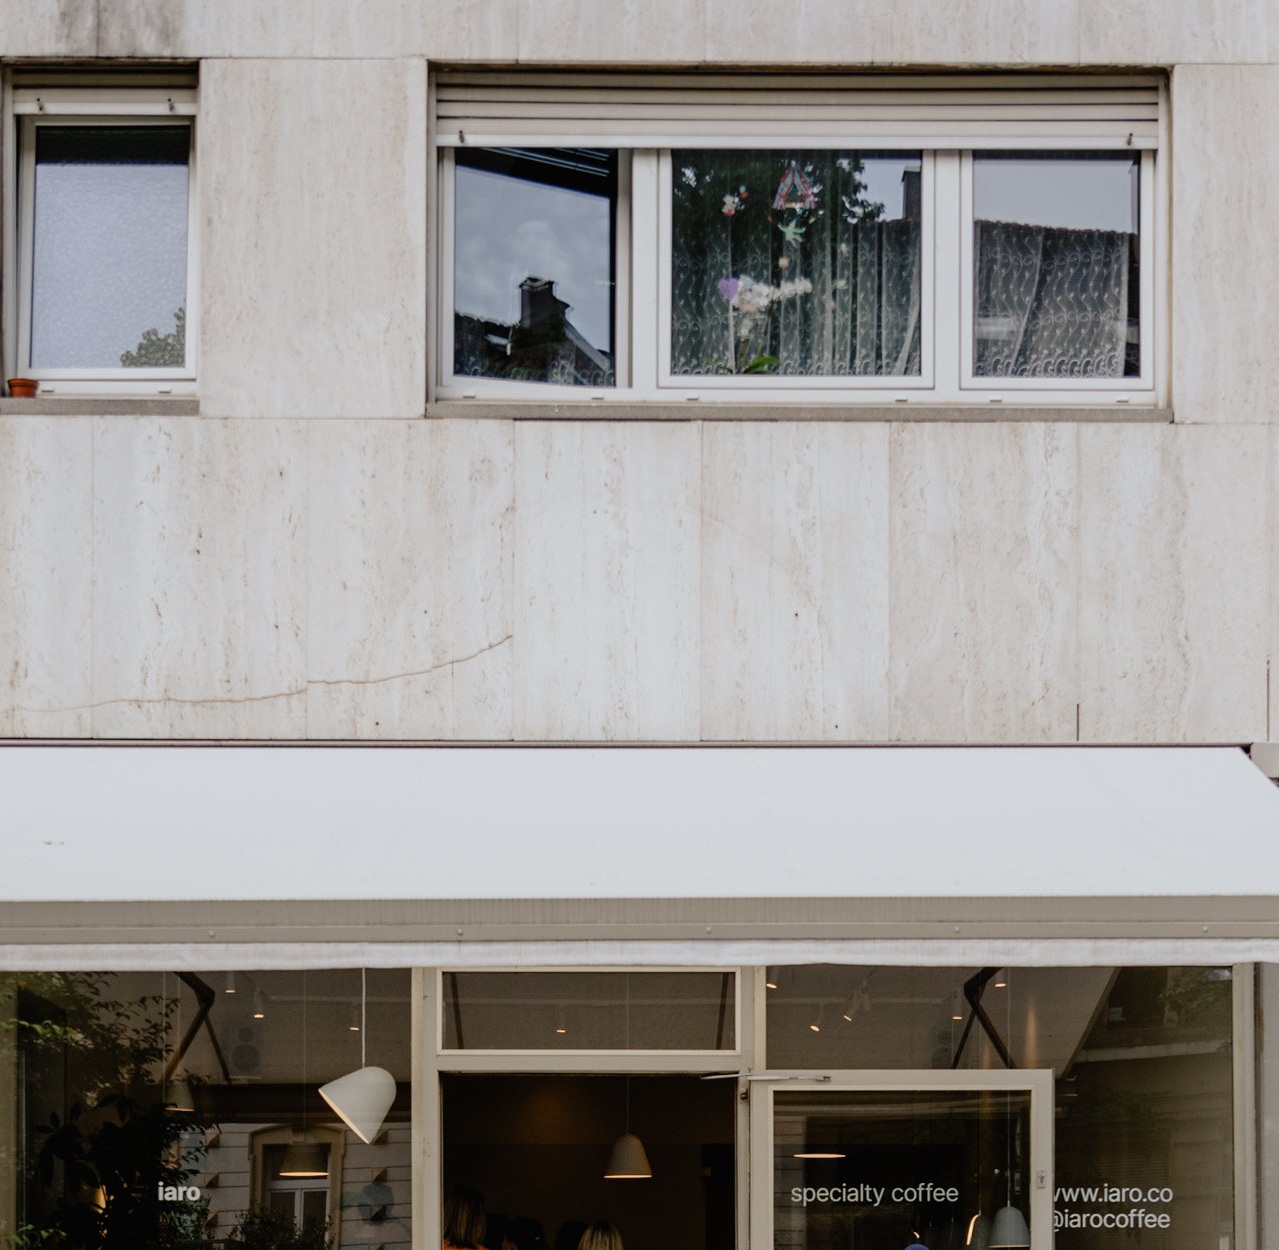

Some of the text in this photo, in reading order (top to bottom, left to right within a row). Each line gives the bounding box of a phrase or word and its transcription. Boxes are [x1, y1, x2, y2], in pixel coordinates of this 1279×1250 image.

[158, 1181, 201, 1201] iaro
[790, 1182, 959, 1207] specialty coffee
